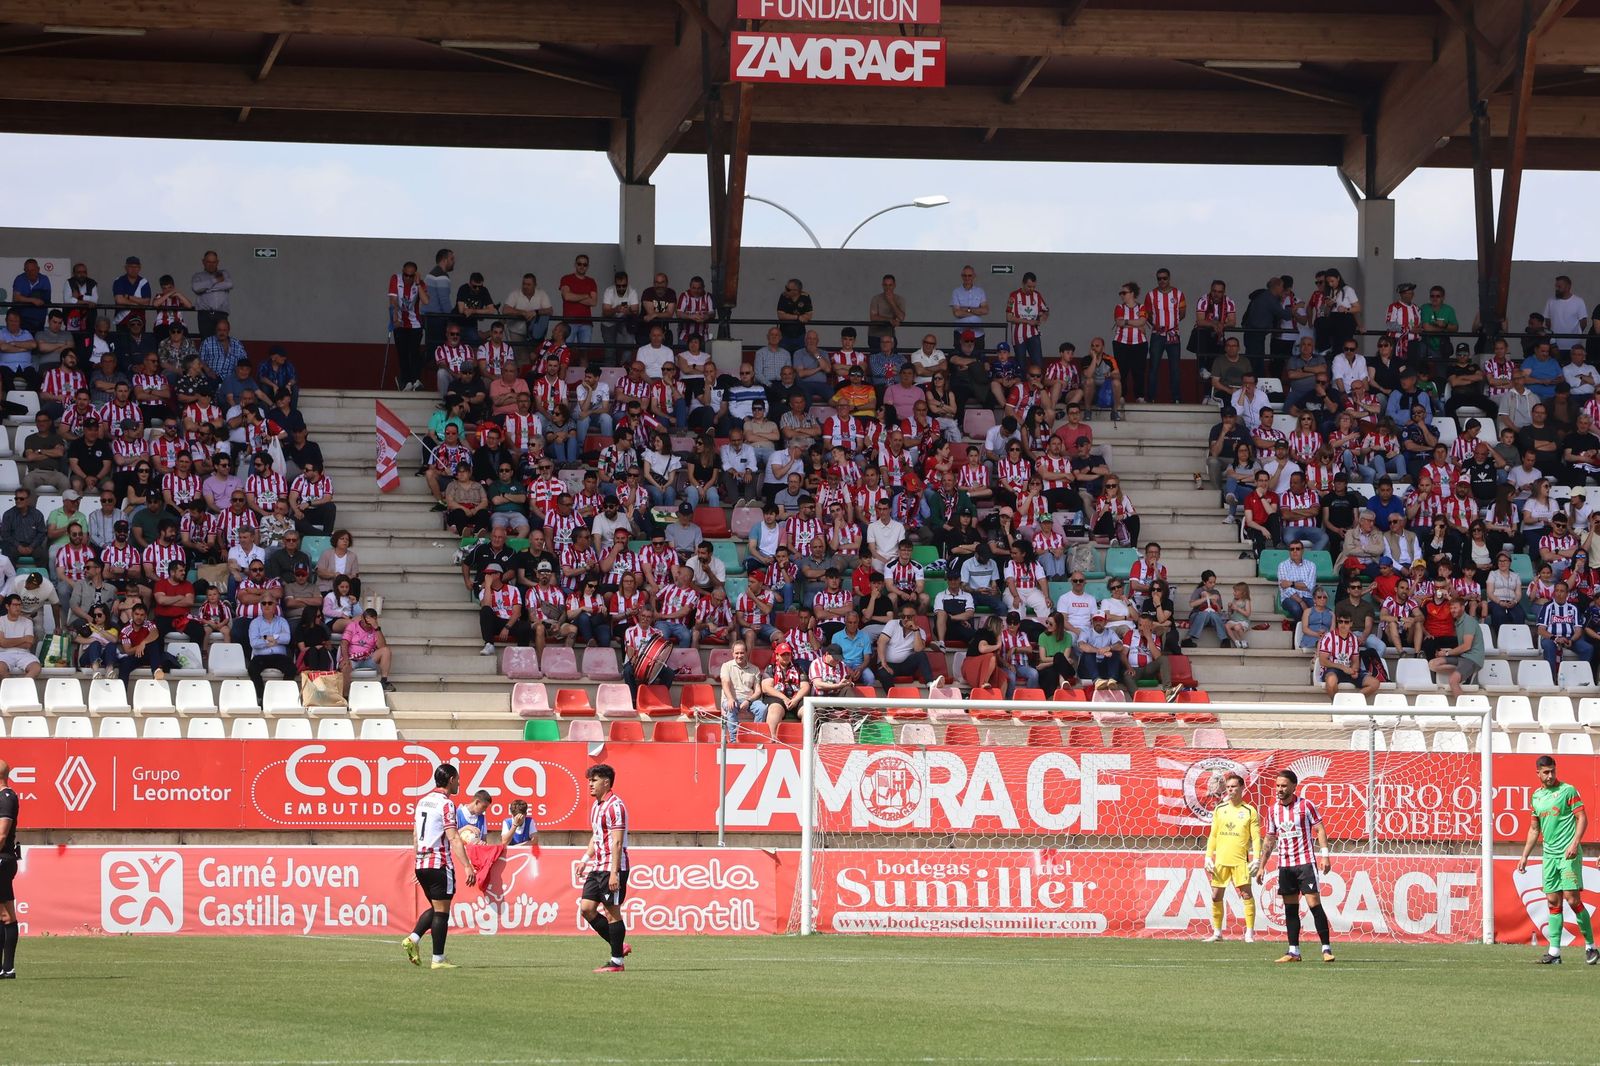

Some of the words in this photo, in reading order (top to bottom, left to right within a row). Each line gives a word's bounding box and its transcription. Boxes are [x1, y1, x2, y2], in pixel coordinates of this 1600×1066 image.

[132, 766, 180, 782] Grupo
[132, 784, 232, 801] Leomotor
[715, 749, 1018, 830] ZAMORA
[1025, 753, 1131, 831] CF
[1300, 782, 1443, 811] CENTRO
[284, 802, 415, 816] EMBUTIDOS
[198, 856, 276, 888] Carné
[281, 857, 359, 888] Joven
[570, 858, 760, 890] Ecuela
[876, 859, 970, 878] bodegas
[1037, 860, 1073, 876] del
[836, 866, 1098, 909] Sumiller
[198, 894, 295, 927] Castilla
[301, 903, 318, 935] y
[324, 895, 388, 927] León
[1393, 871, 1477, 935] CF
[838, 915, 1097, 931] www.bodegasdelsumiller.com
